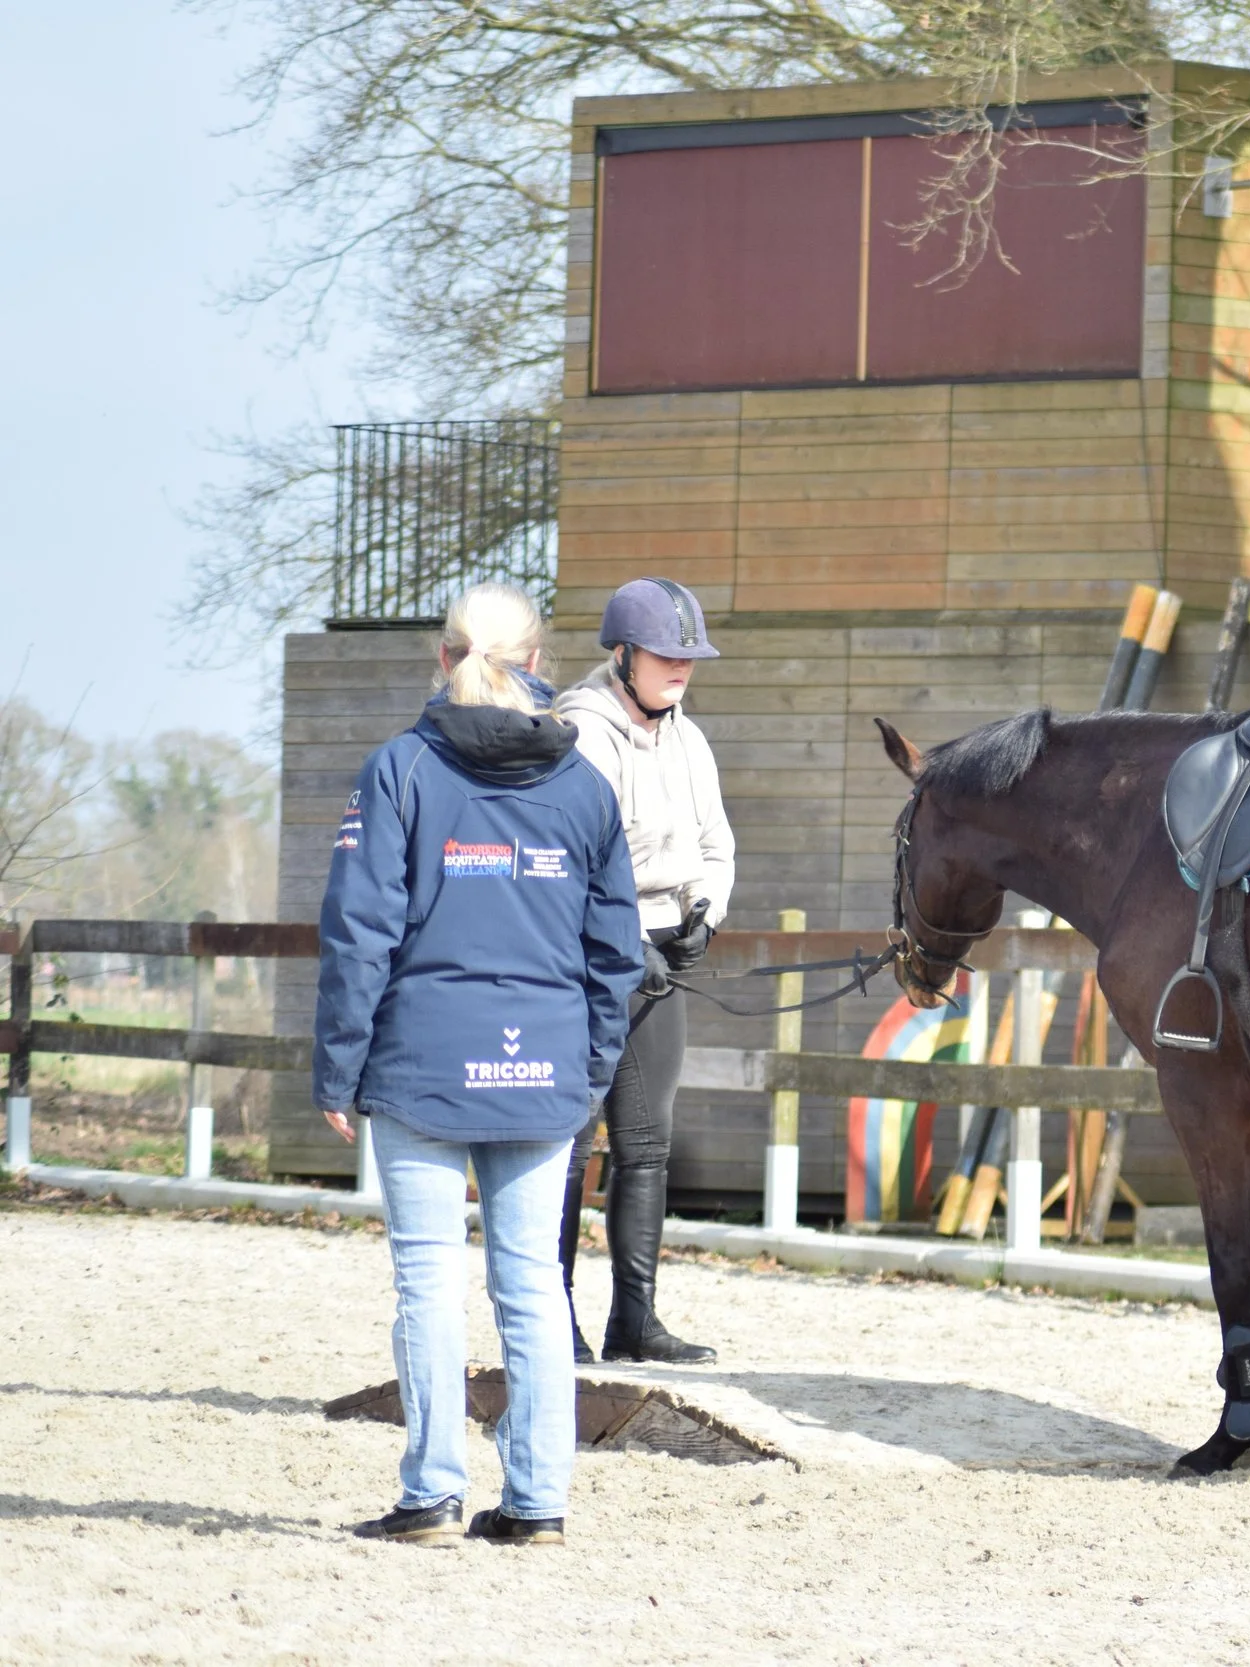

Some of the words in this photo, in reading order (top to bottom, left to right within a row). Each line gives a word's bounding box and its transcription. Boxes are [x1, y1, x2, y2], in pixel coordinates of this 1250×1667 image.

[458, 844, 512, 855] WORKING
[444, 855, 512, 867] EQUITATION
[465, 1062, 554, 1080] TRICORP
